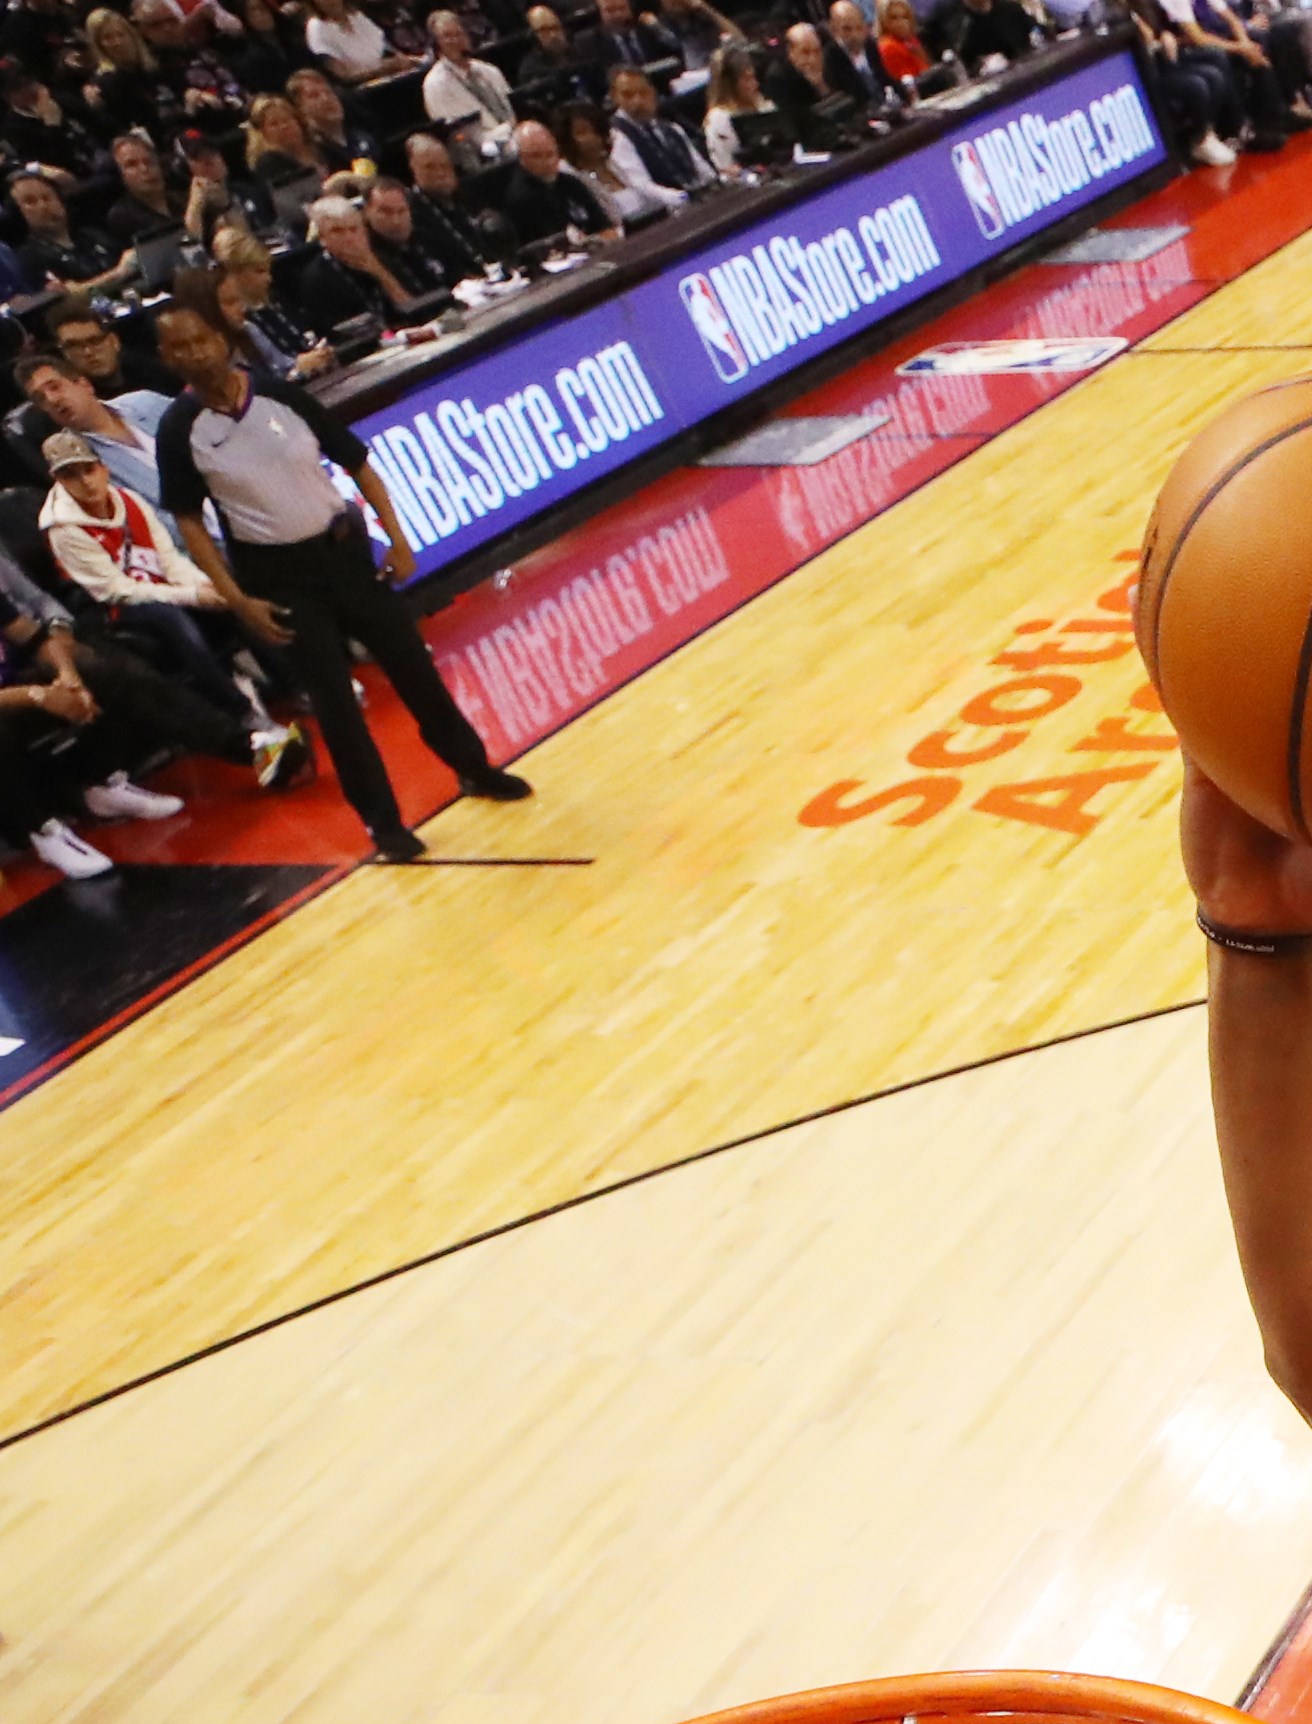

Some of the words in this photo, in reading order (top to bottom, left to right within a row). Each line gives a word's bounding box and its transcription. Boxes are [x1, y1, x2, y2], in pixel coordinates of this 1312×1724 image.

[974, 84, 1156, 227] NBAStore.com
[708, 194, 942, 367] NBAStore.com
[366, 341, 665, 553] NBAStore.com
